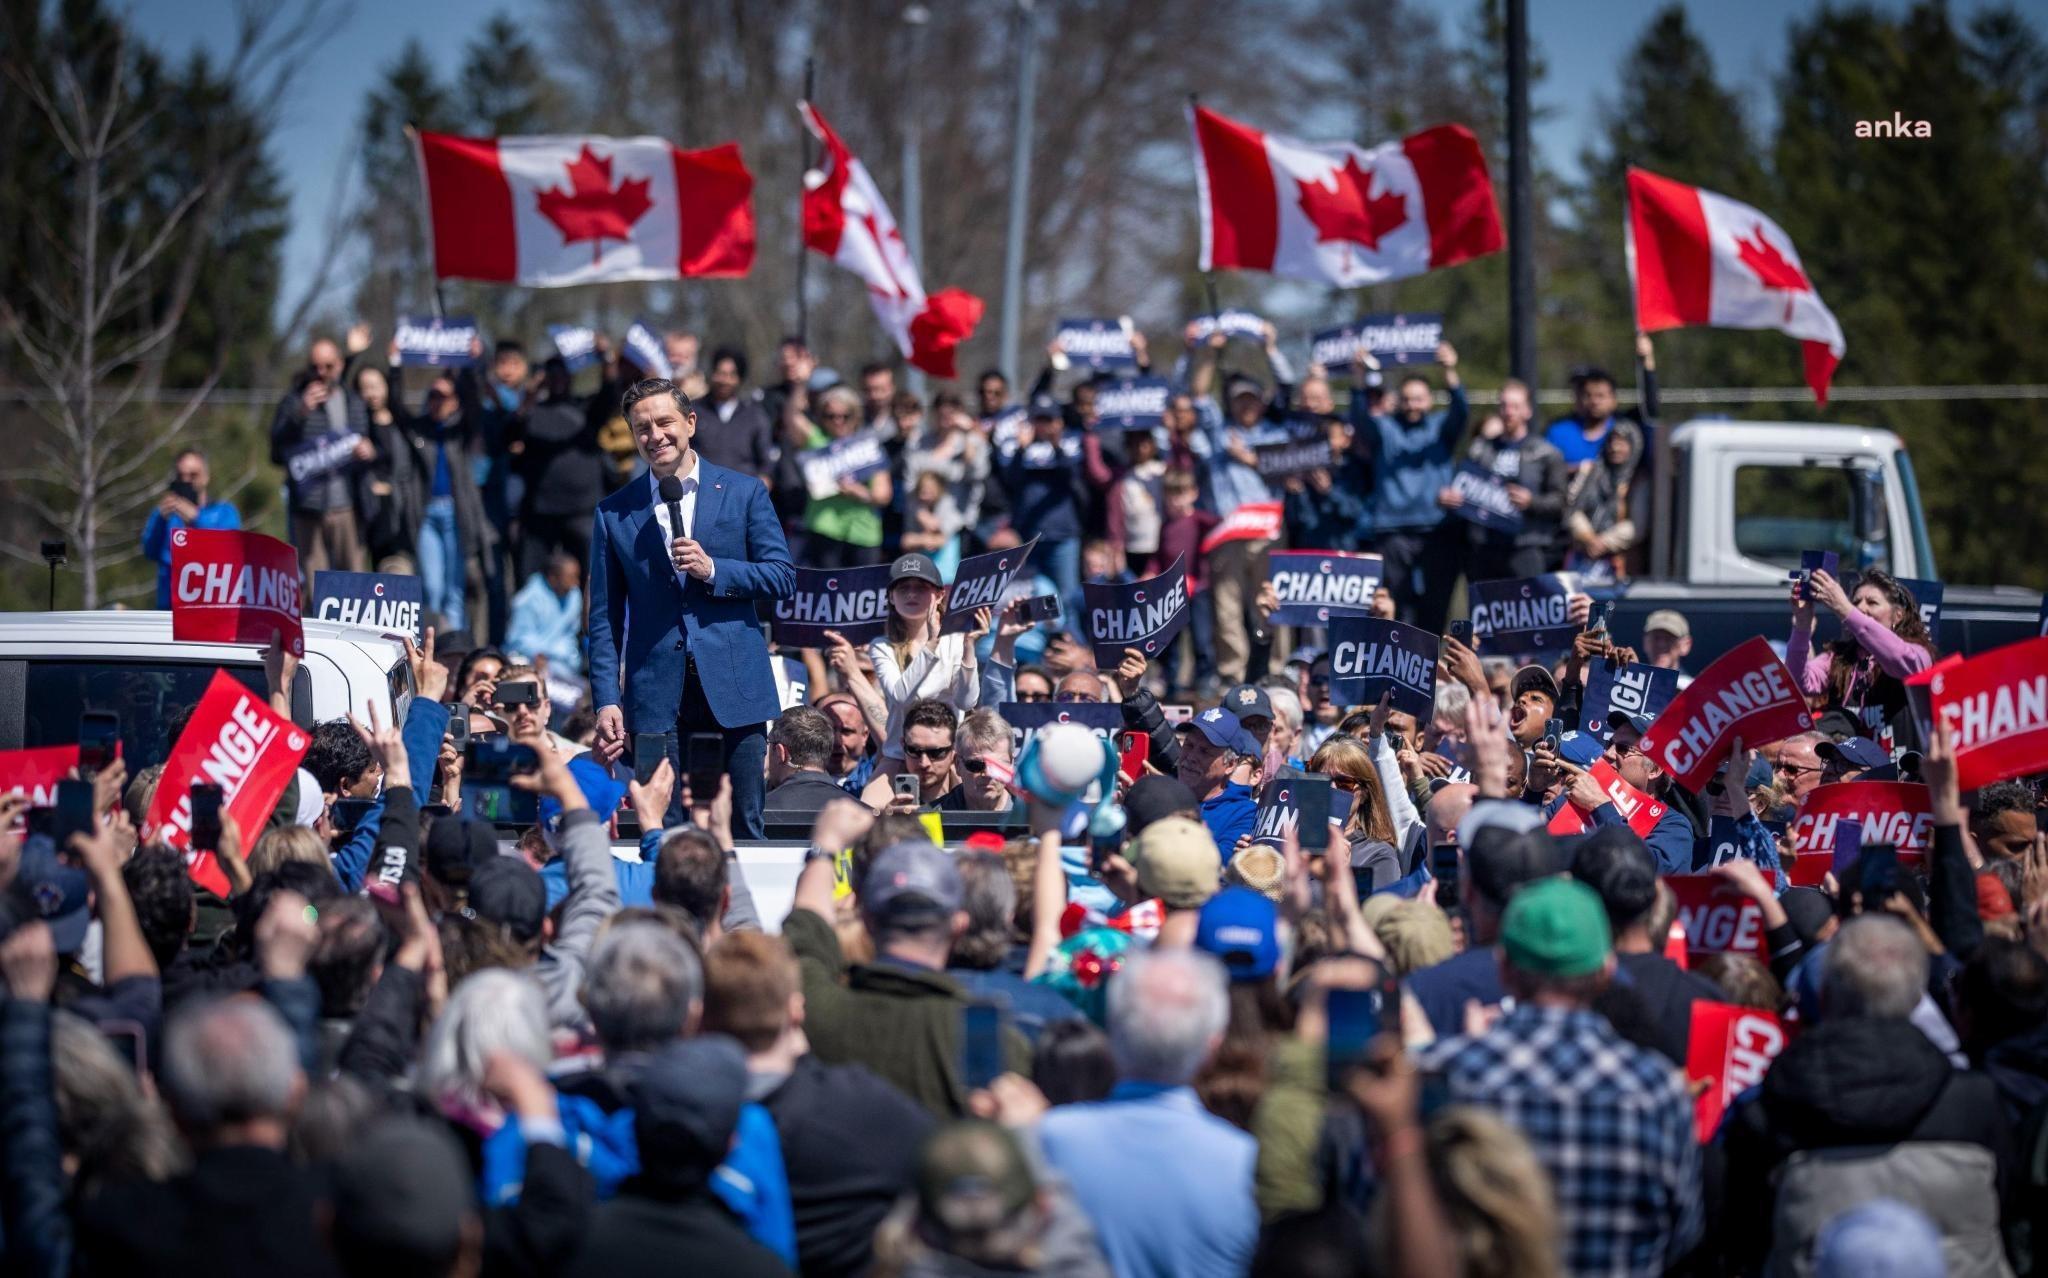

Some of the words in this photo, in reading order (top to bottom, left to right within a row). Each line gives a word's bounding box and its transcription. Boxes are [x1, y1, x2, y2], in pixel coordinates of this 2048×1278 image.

[178, 562, 300, 617] CHANGE
[775, 588, 890, 623] CHANGE
[950, 569, 1015, 610] CHAN
[1092, 575, 1185, 640] CHANGE
[1272, 571, 1379, 605] CHANGE
[318, 597, 420, 635] CHANGE
[1489, 594, 1566, 629] CHANG
[1333, 641, 1435, 691] CHANGE
[1664, 662, 1792, 775] CHANGE
[1941, 674, 2048, 748] CHAN
